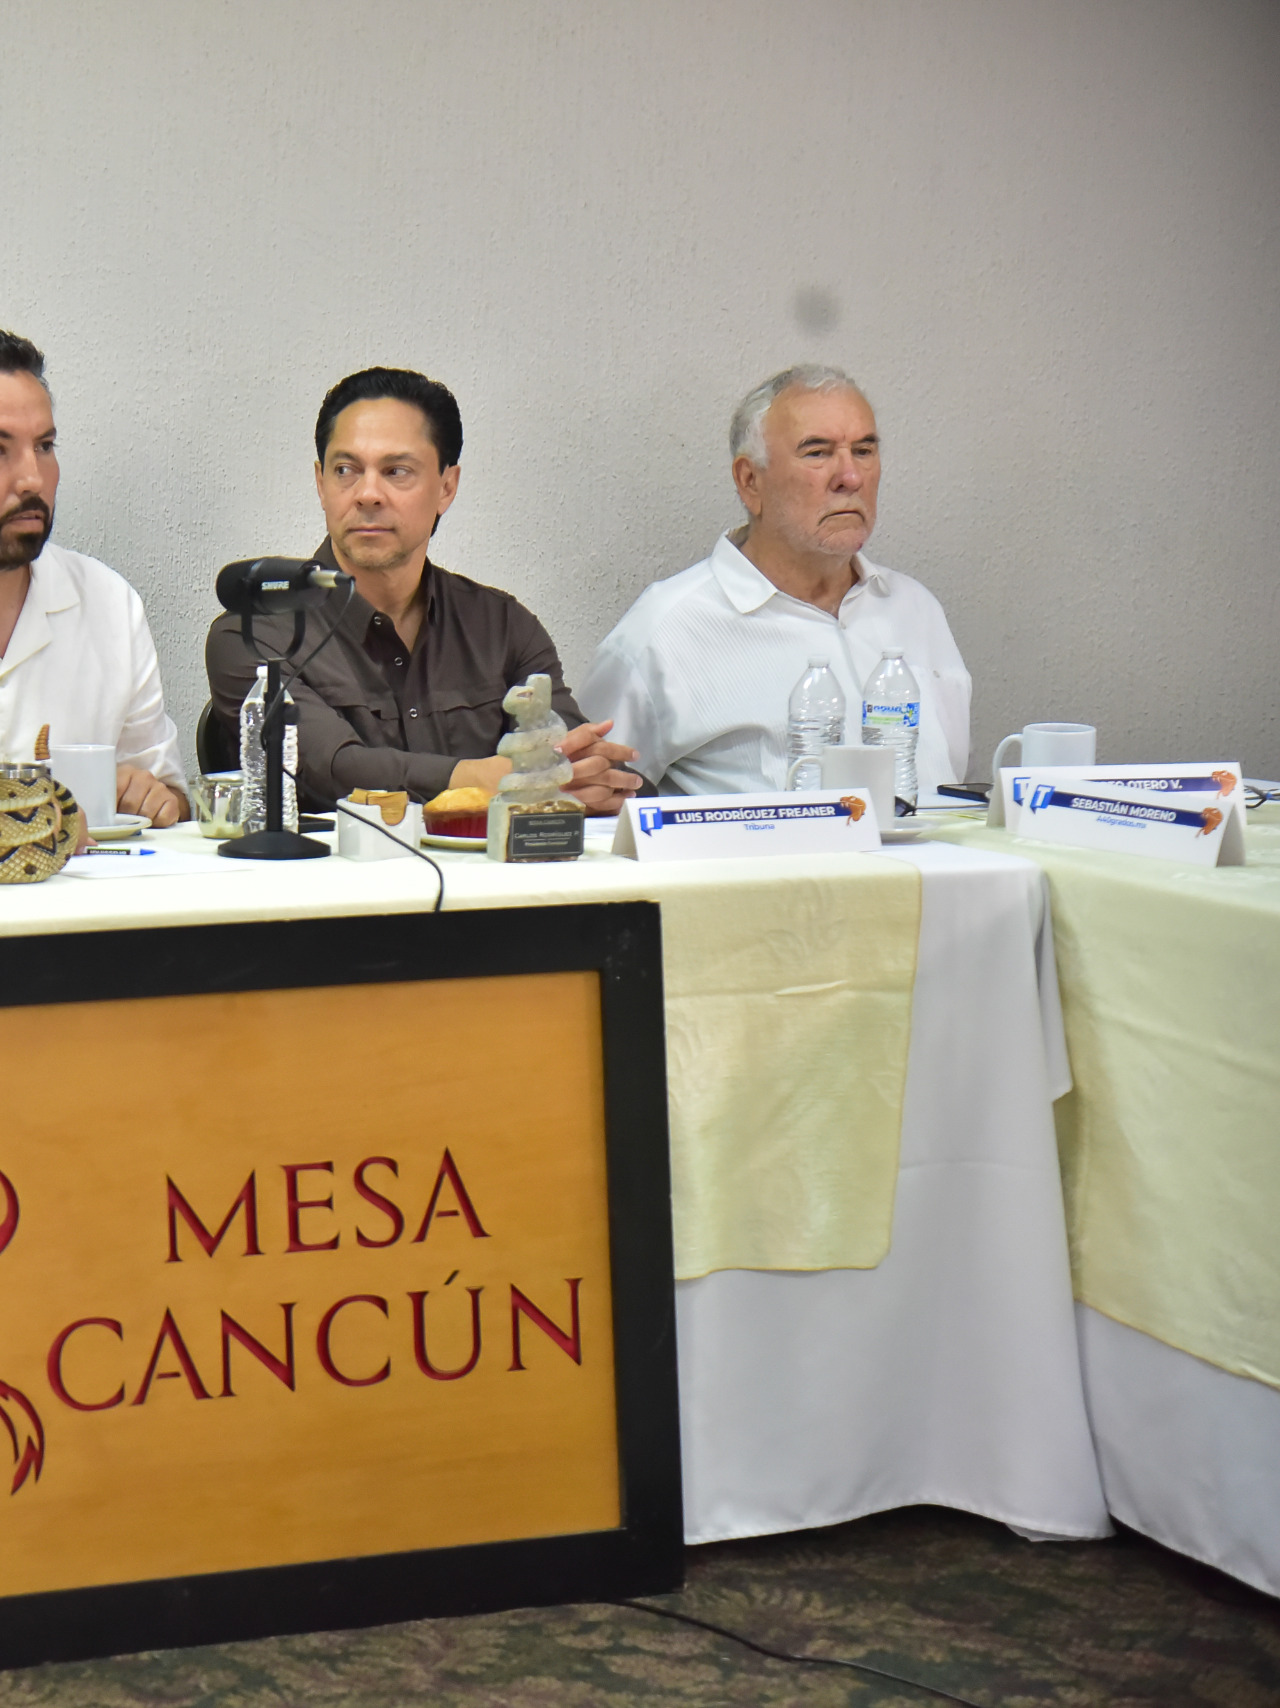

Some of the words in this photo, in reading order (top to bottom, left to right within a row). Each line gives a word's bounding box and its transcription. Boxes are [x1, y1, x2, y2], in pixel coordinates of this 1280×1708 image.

[261, 580, 290, 590] SHURE
[1170, 779, 1183, 789] V.
[675, 811, 704, 823] LUIS
[704, 807, 777, 821] RODRÍGUEZ
[778, 805, 836, 818] FREANER
[1071, 797, 1129, 815] SEBASTIÁN
[1129, 805, 1177, 822] MORENO
[743, 822, 775, 831] Tribuna
[164, 1146, 491, 1264] MESA
[46, 1269, 584, 1412] CANCÚN
